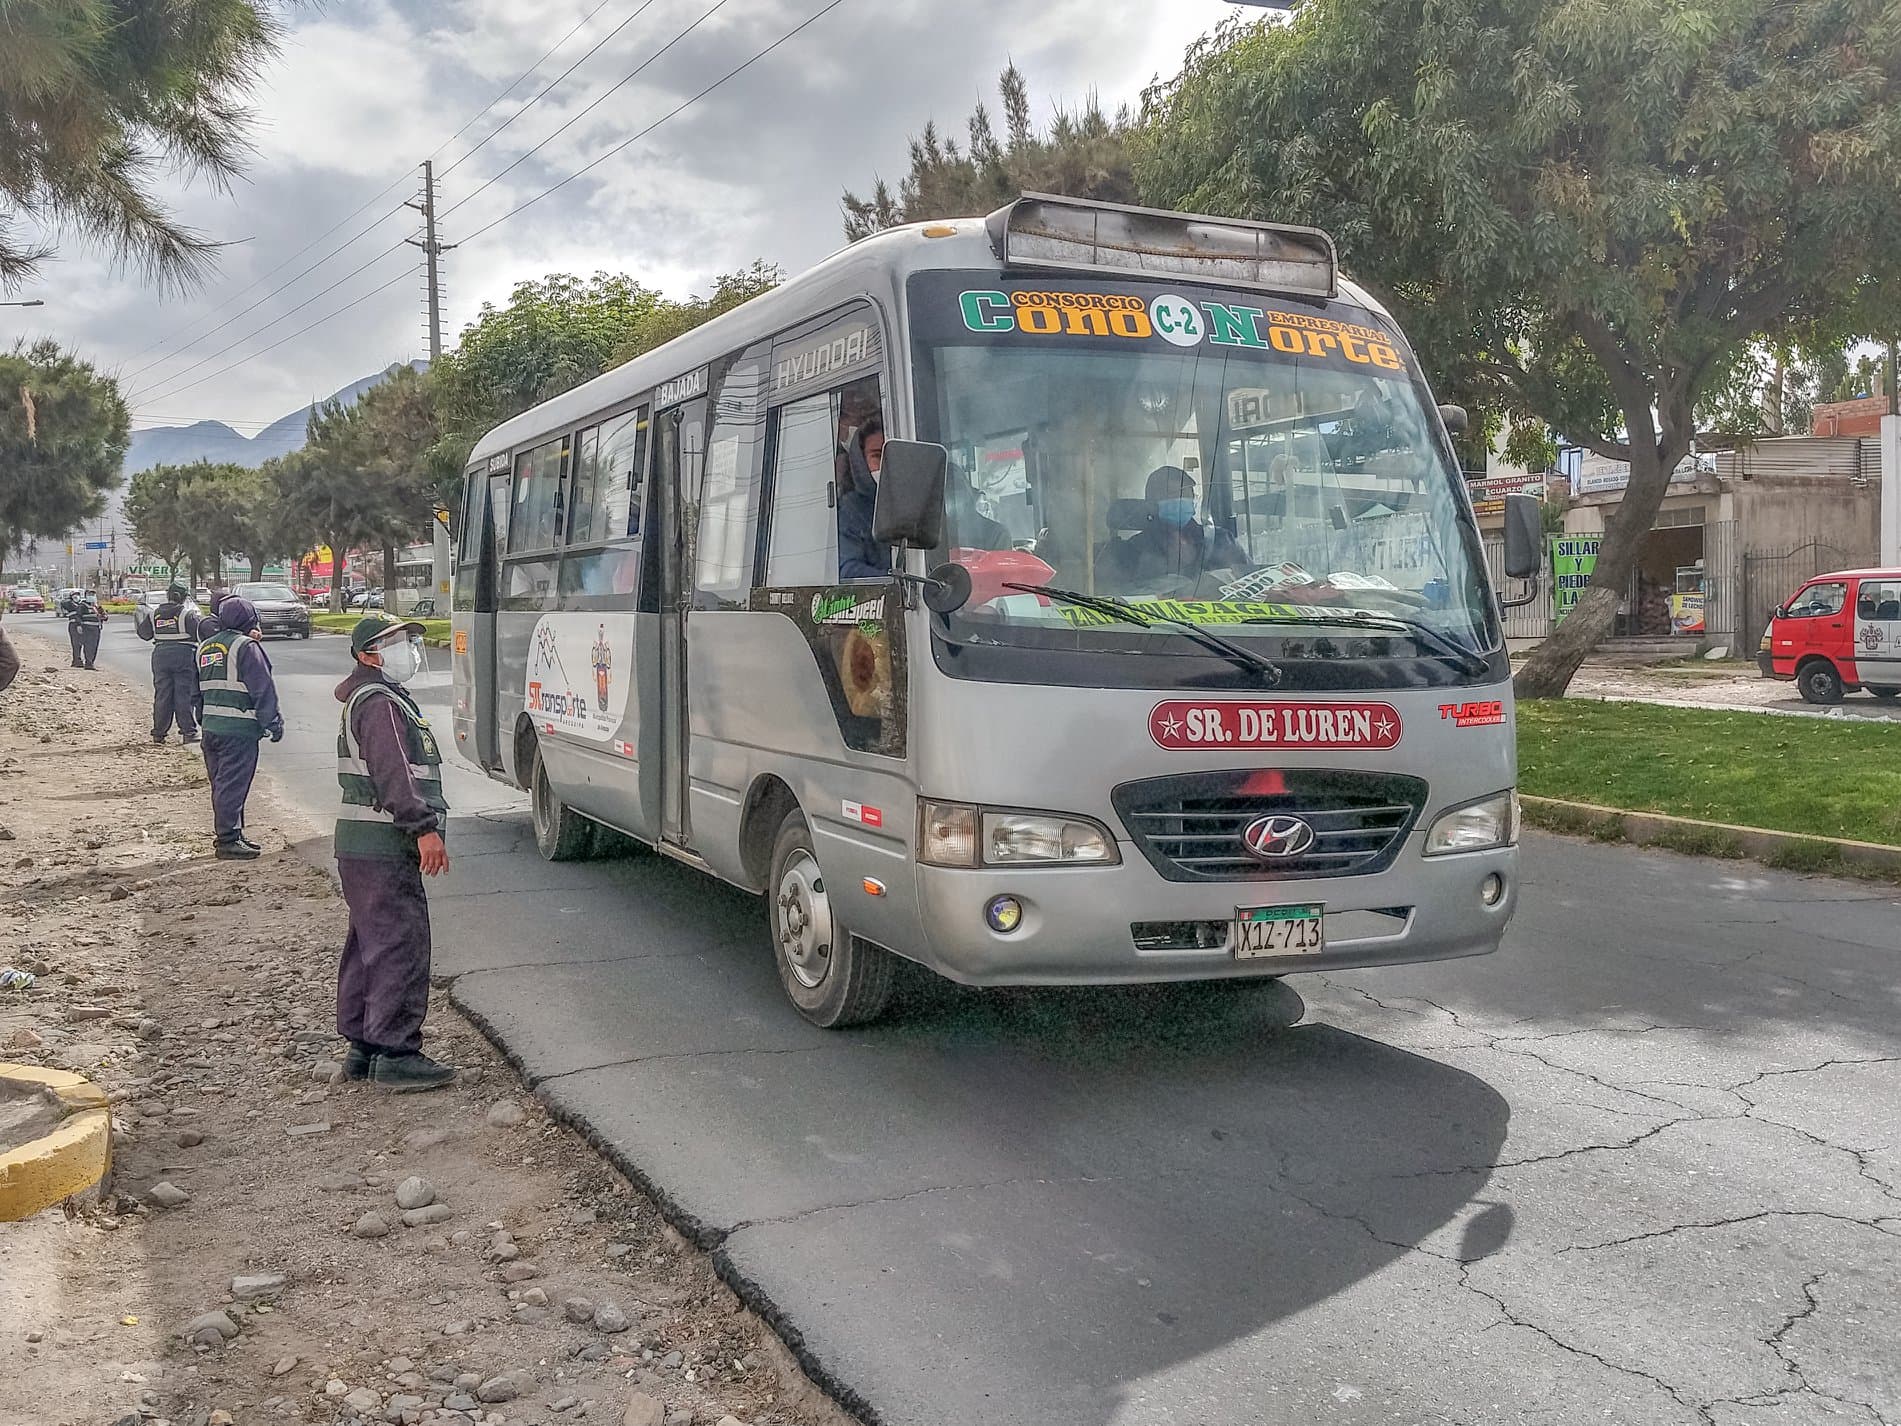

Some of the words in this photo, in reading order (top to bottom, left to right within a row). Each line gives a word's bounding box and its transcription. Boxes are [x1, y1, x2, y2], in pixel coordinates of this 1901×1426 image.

[1011, 291, 1145, 312] CONSORCIO
[1155, 304, 1198, 335] C-2
[1267, 311, 1392, 344] EMPRESARIAL
[777, 328, 868, 389] HYUNDAI
[661, 373, 700, 404] BAJADA
[1470, 479, 1504, 489] MARMOL
[1505, 475, 1541, 484] GRANITO
[1558, 541, 1599, 557] SILLAR
[1574, 557, 1583, 572] Y
[1187, 601, 1295, 616] SAGA
[1438, 700, 1503, 719] TURBO
[1186, 708, 1233, 742] SR.
[1238, 708, 1280, 741] DE
[1283, 709, 1372, 742] LUREN
[1240, 918, 1320, 951] X1Z-713
